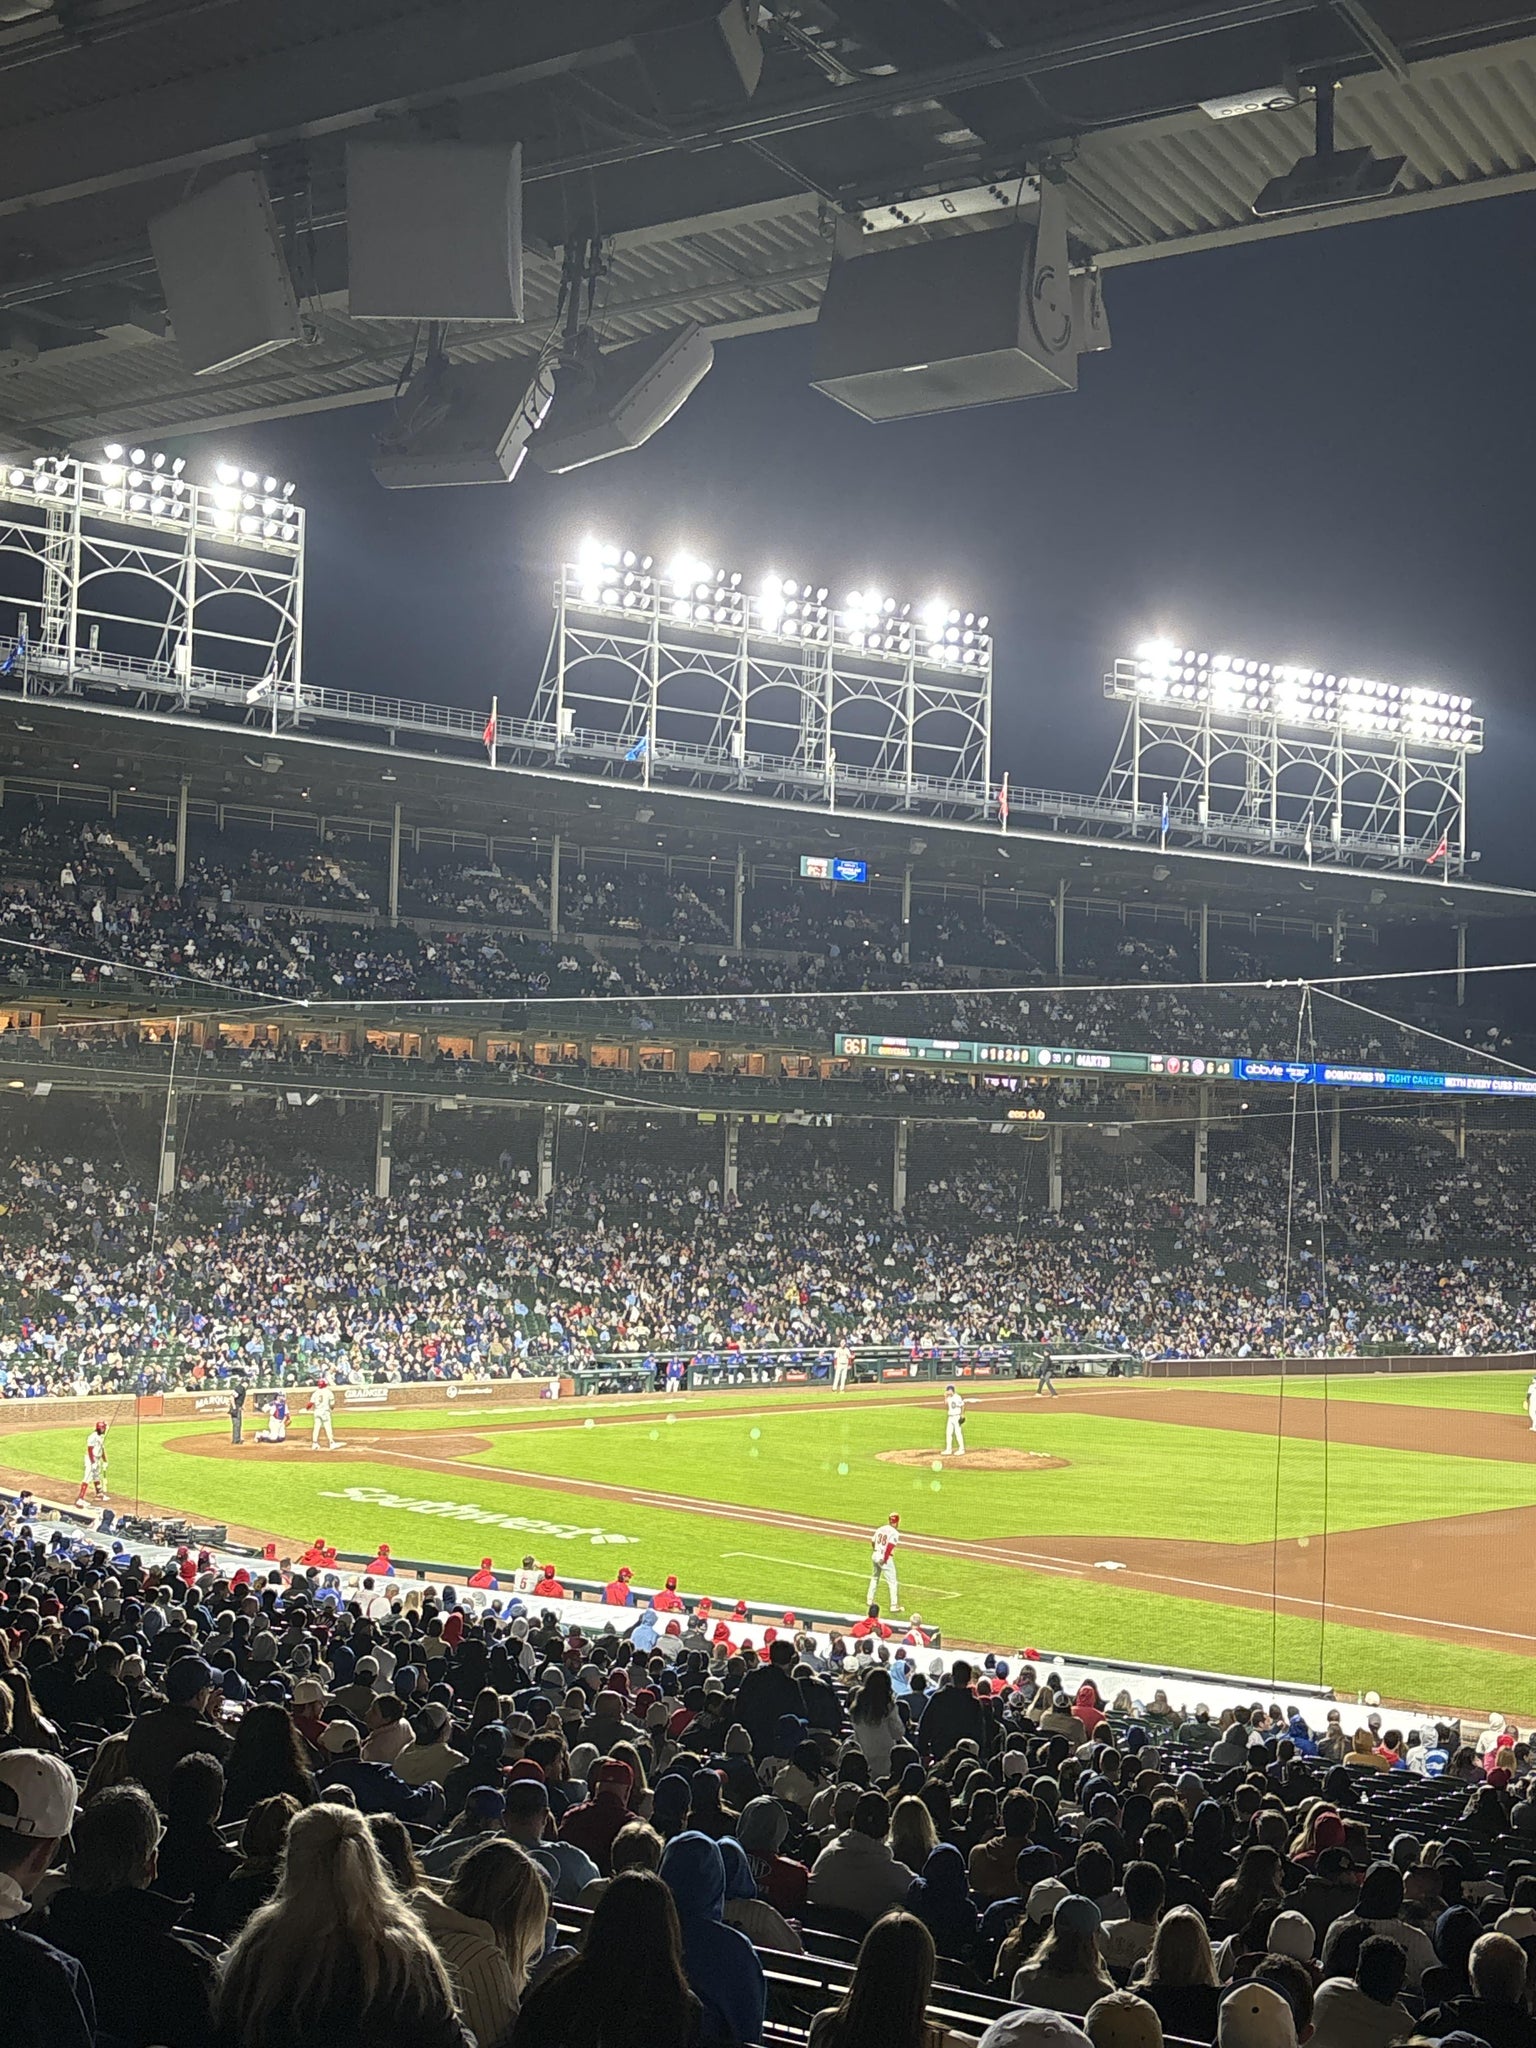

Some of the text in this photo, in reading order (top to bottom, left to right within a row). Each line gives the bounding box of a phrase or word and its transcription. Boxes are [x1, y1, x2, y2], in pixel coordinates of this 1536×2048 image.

[844, 1038, 860, 1054] 86
[990, 1048, 996, 1060] 1
[1005, 1049, 1012, 1061] 2
[1182, 1061, 1189, 1073] 2
[1246, 1064, 1283, 1075] abbvie
[1325, 1070, 1373, 1083] DONATIONS
[1375, 1073, 1385, 1083] TO
[1387, 1074, 1411, 1084] FIGHT
[1412, 1075, 1444, 1086] CANCER
[1445, 1077, 1466, 1088] WITH
[1467, 1079, 1492, 1089] EVERY
[344, 1388, 389, 1399] GRAINGER
[316, 1486, 606, 1540] Southwest
